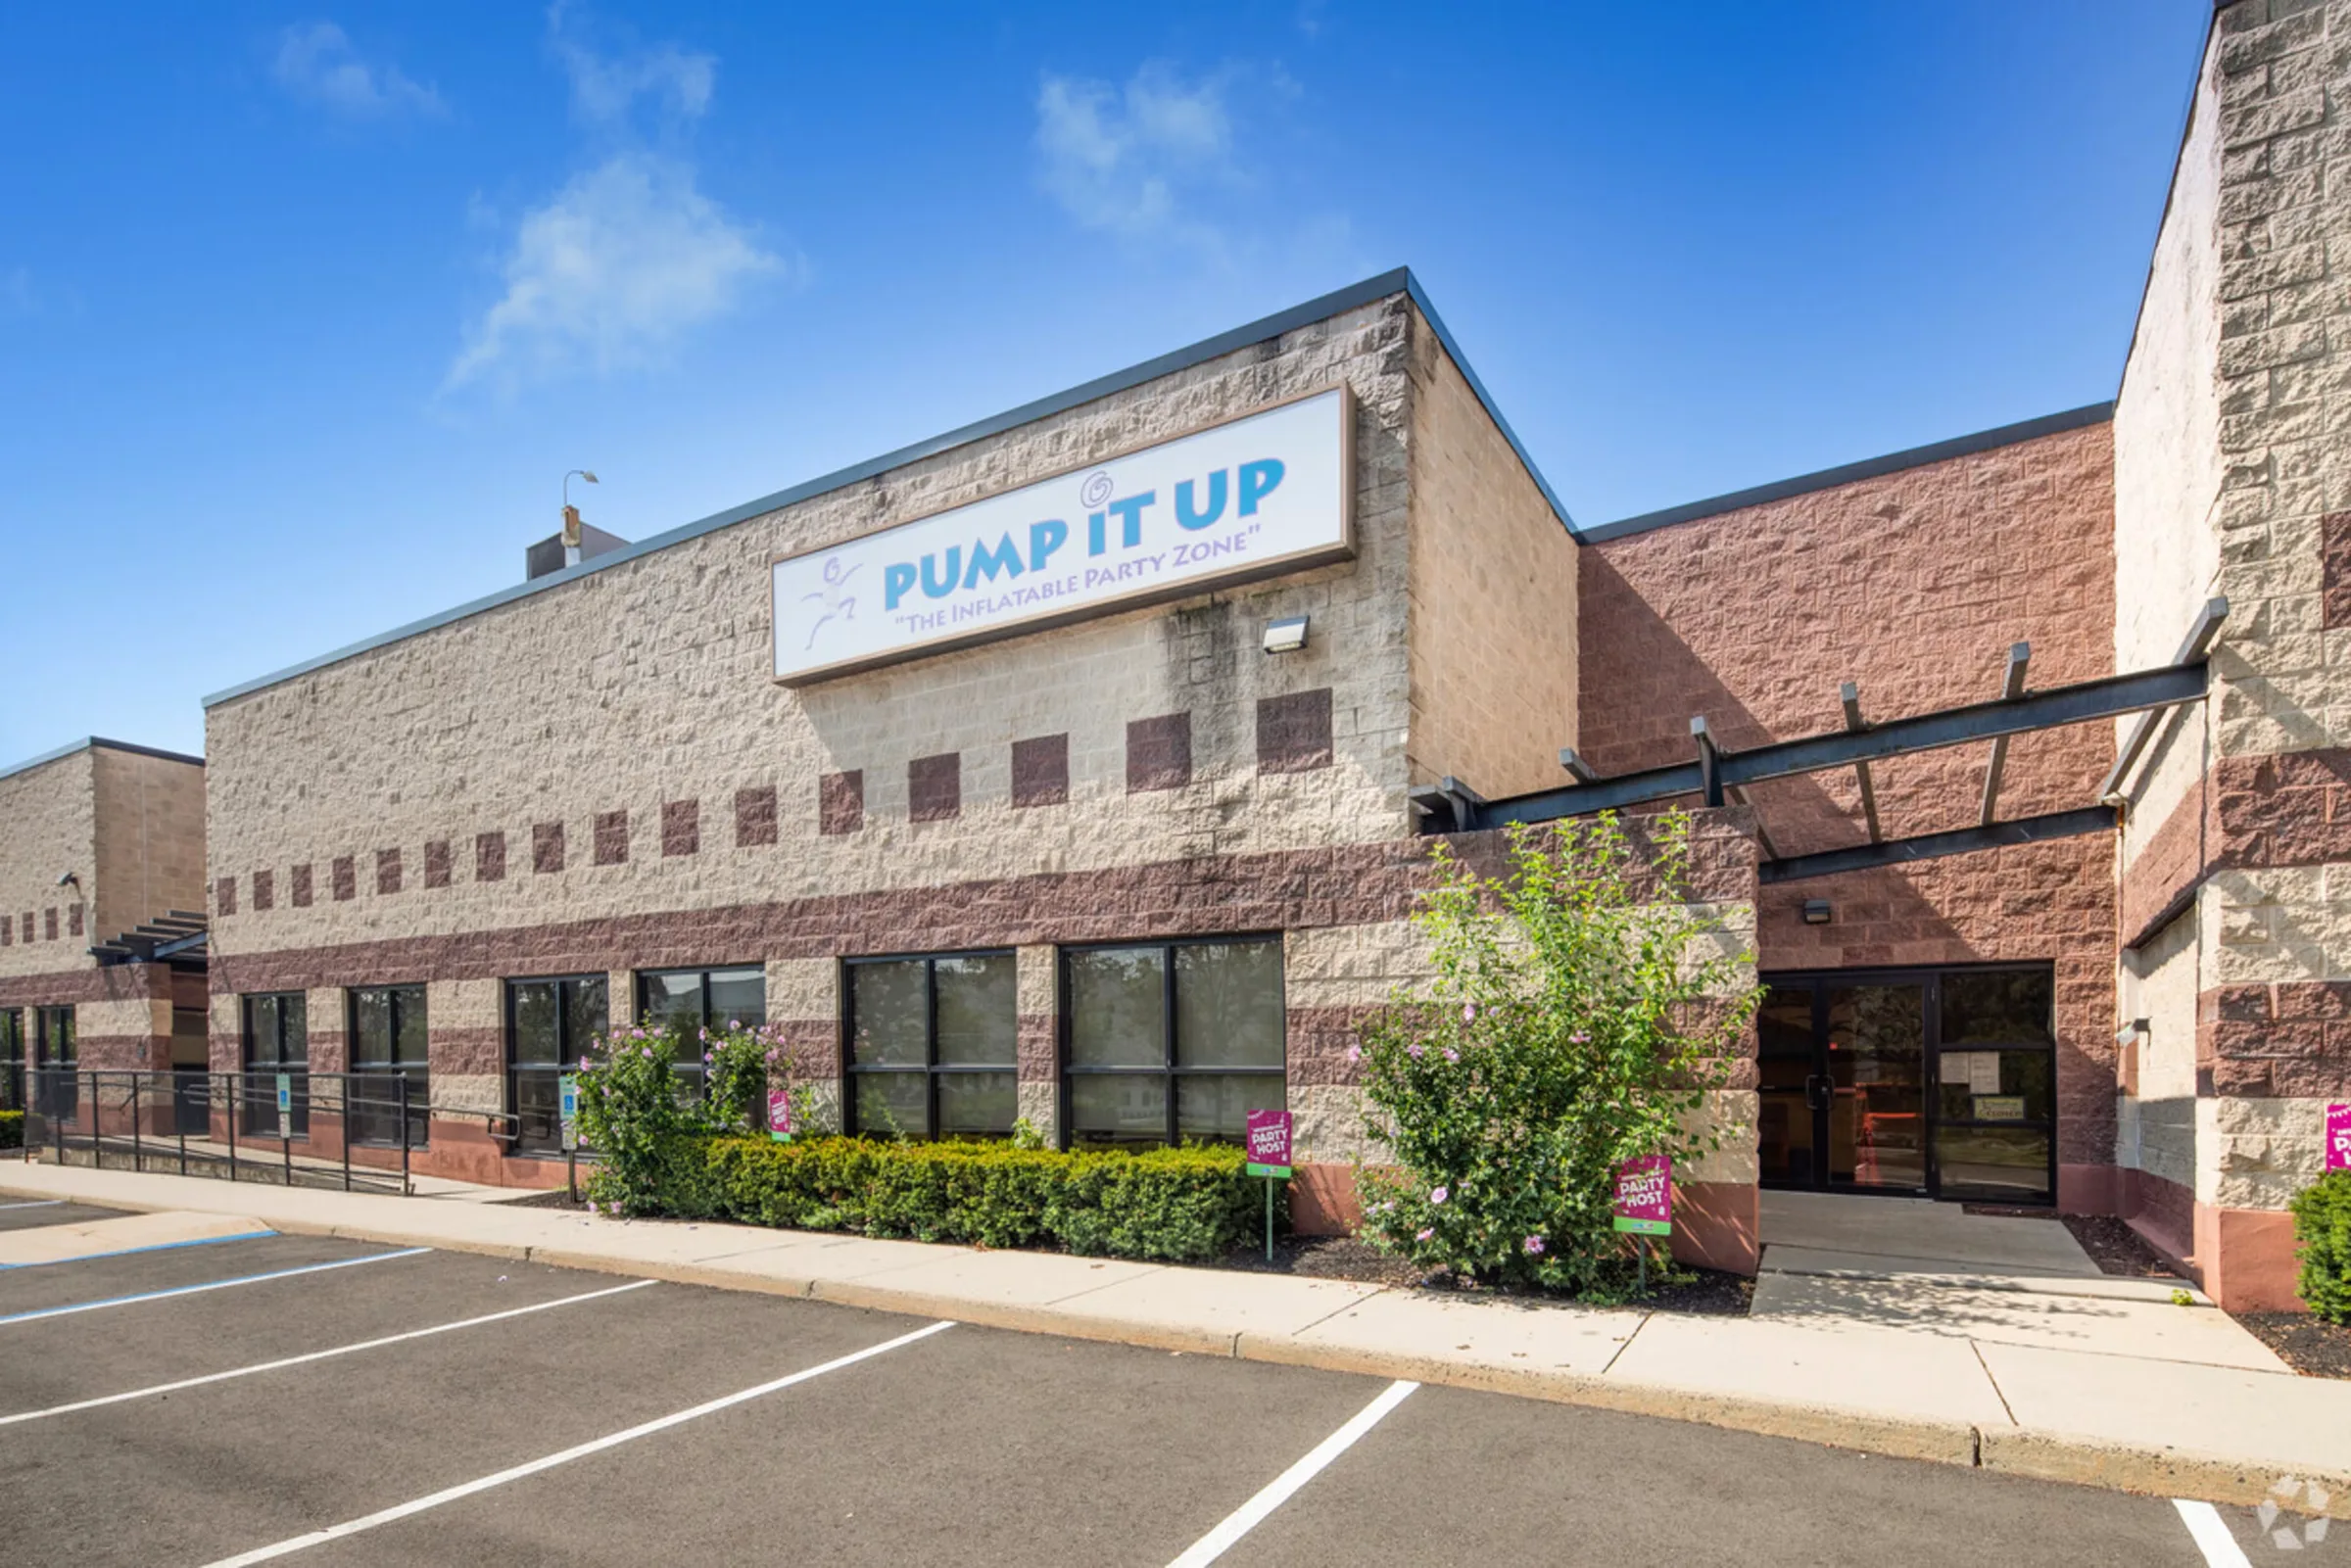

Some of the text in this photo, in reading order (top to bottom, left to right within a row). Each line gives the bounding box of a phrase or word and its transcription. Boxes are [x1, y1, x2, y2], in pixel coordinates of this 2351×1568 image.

[884, 519, 1070, 612] PUMP
[1175, 457, 1286, 531] UP
[952, 575, 1079, 623] INFLATABLE
[1084, 552, 1167, 589] PARTY
[1251, 1128, 1288, 1145] PARTY
[1256, 1140, 1286, 1156] HOST
[1619, 1176, 1665, 1195] PARTY
[1626, 1191, 1662, 1208] HOST
